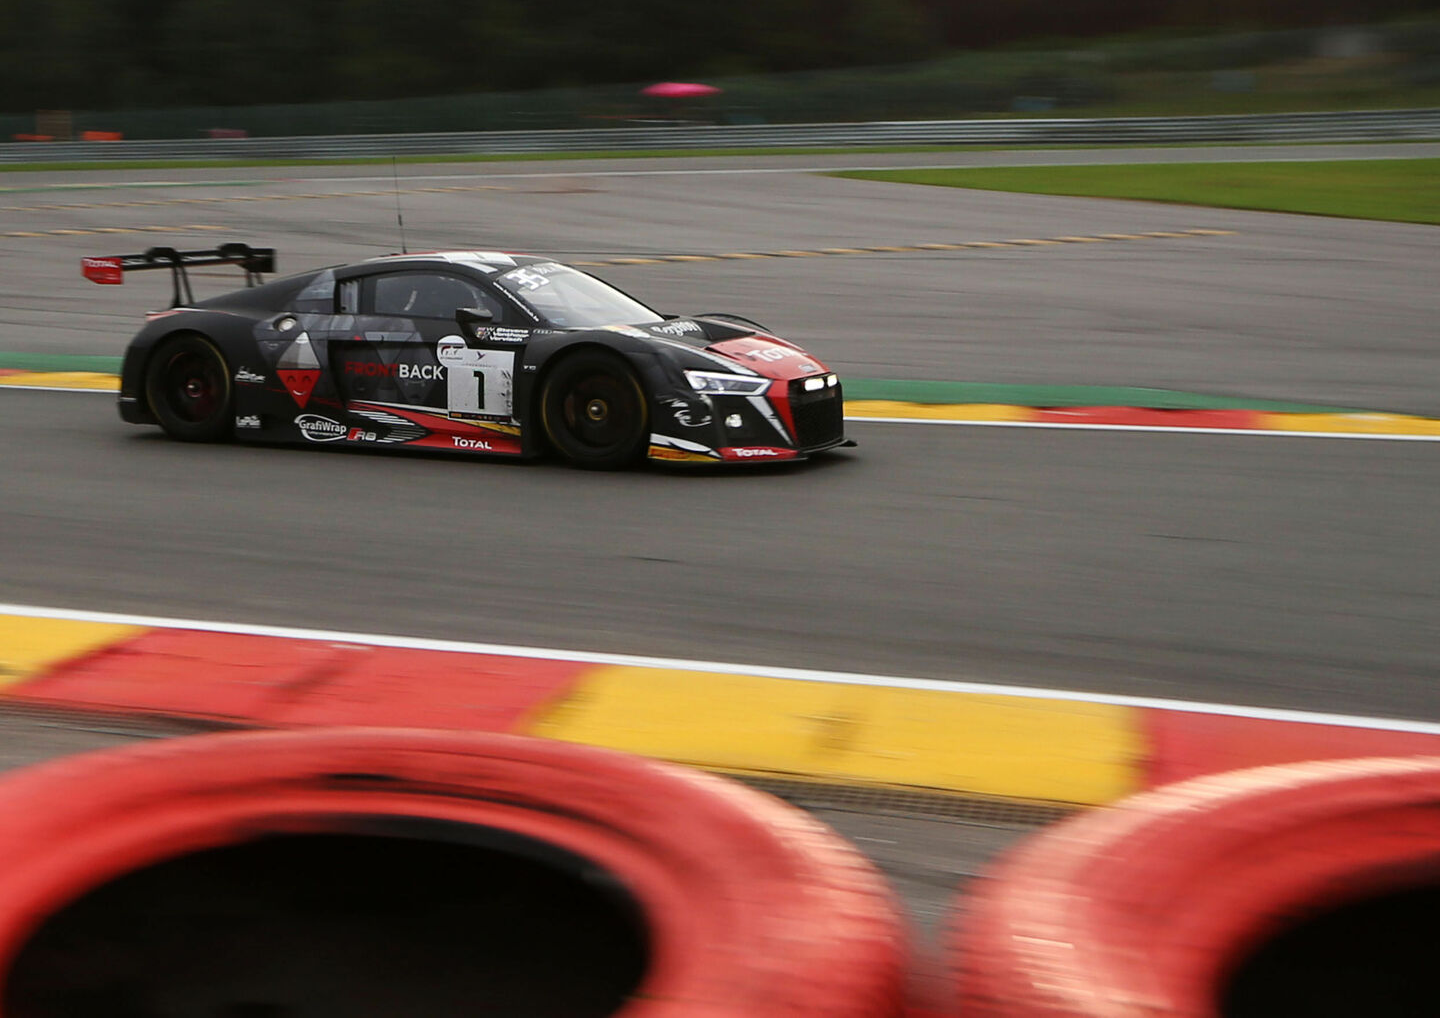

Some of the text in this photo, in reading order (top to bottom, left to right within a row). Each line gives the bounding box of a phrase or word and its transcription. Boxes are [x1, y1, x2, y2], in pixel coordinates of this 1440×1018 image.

[473, 370, 485, 410] 1
[299, 419, 347, 435] GrafiWrap
[452, 436, 492, 450] TOTAL
[732, 448, 778, 457] TOTAL
